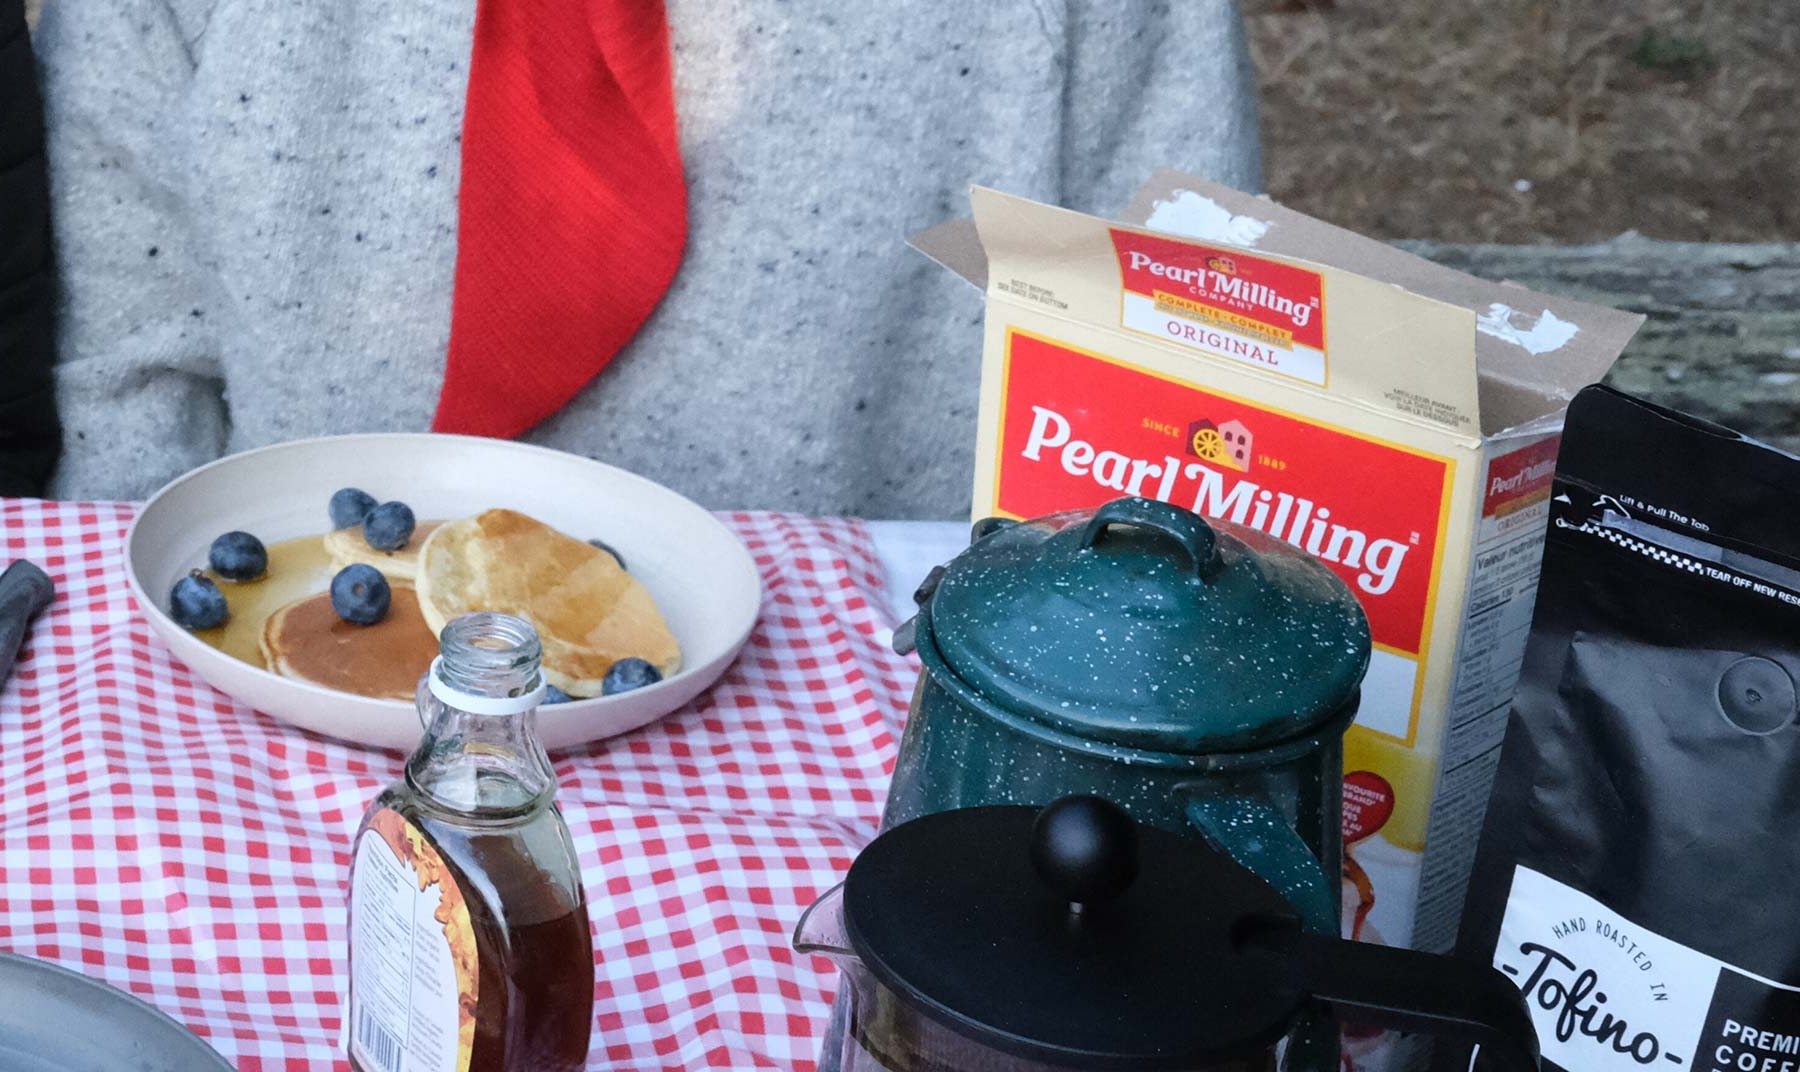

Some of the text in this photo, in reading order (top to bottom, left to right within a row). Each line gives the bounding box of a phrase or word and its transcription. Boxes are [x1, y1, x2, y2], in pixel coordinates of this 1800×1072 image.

[1129, 251, 1205, 288] Pearl
[1207, 270, 1314, 327] Milling
[1189, 285, 1254, 311] COMPANY
[1158, 294, 1221, 318] COMPLETE
[1230, 316, 1287, 338] COMPLET
[1166, 320, 1279, 366] ORIGINAL
[1142, 417, 1287, 471] SINCE 1889
[1021, 405, 1413, 596] Pearl Milling
[1489, 470, 1524, 497] Pearl
[1619, 494, 1635, 506] Lift
[1636, 501, 1645, 509] &
[1647, 504, 1667, 517] Pull
[1669, 510, 1689, 524] The
[1705, 567, 1732, 582] TEAR
[1732, 576, 1752, 588] OFF
[1753, 583, 1777, 598] NEW
[1551, 917, 1668, 1001] HAND ROASTED IN
[1721, 1018, 1800, 1055] PREMI
